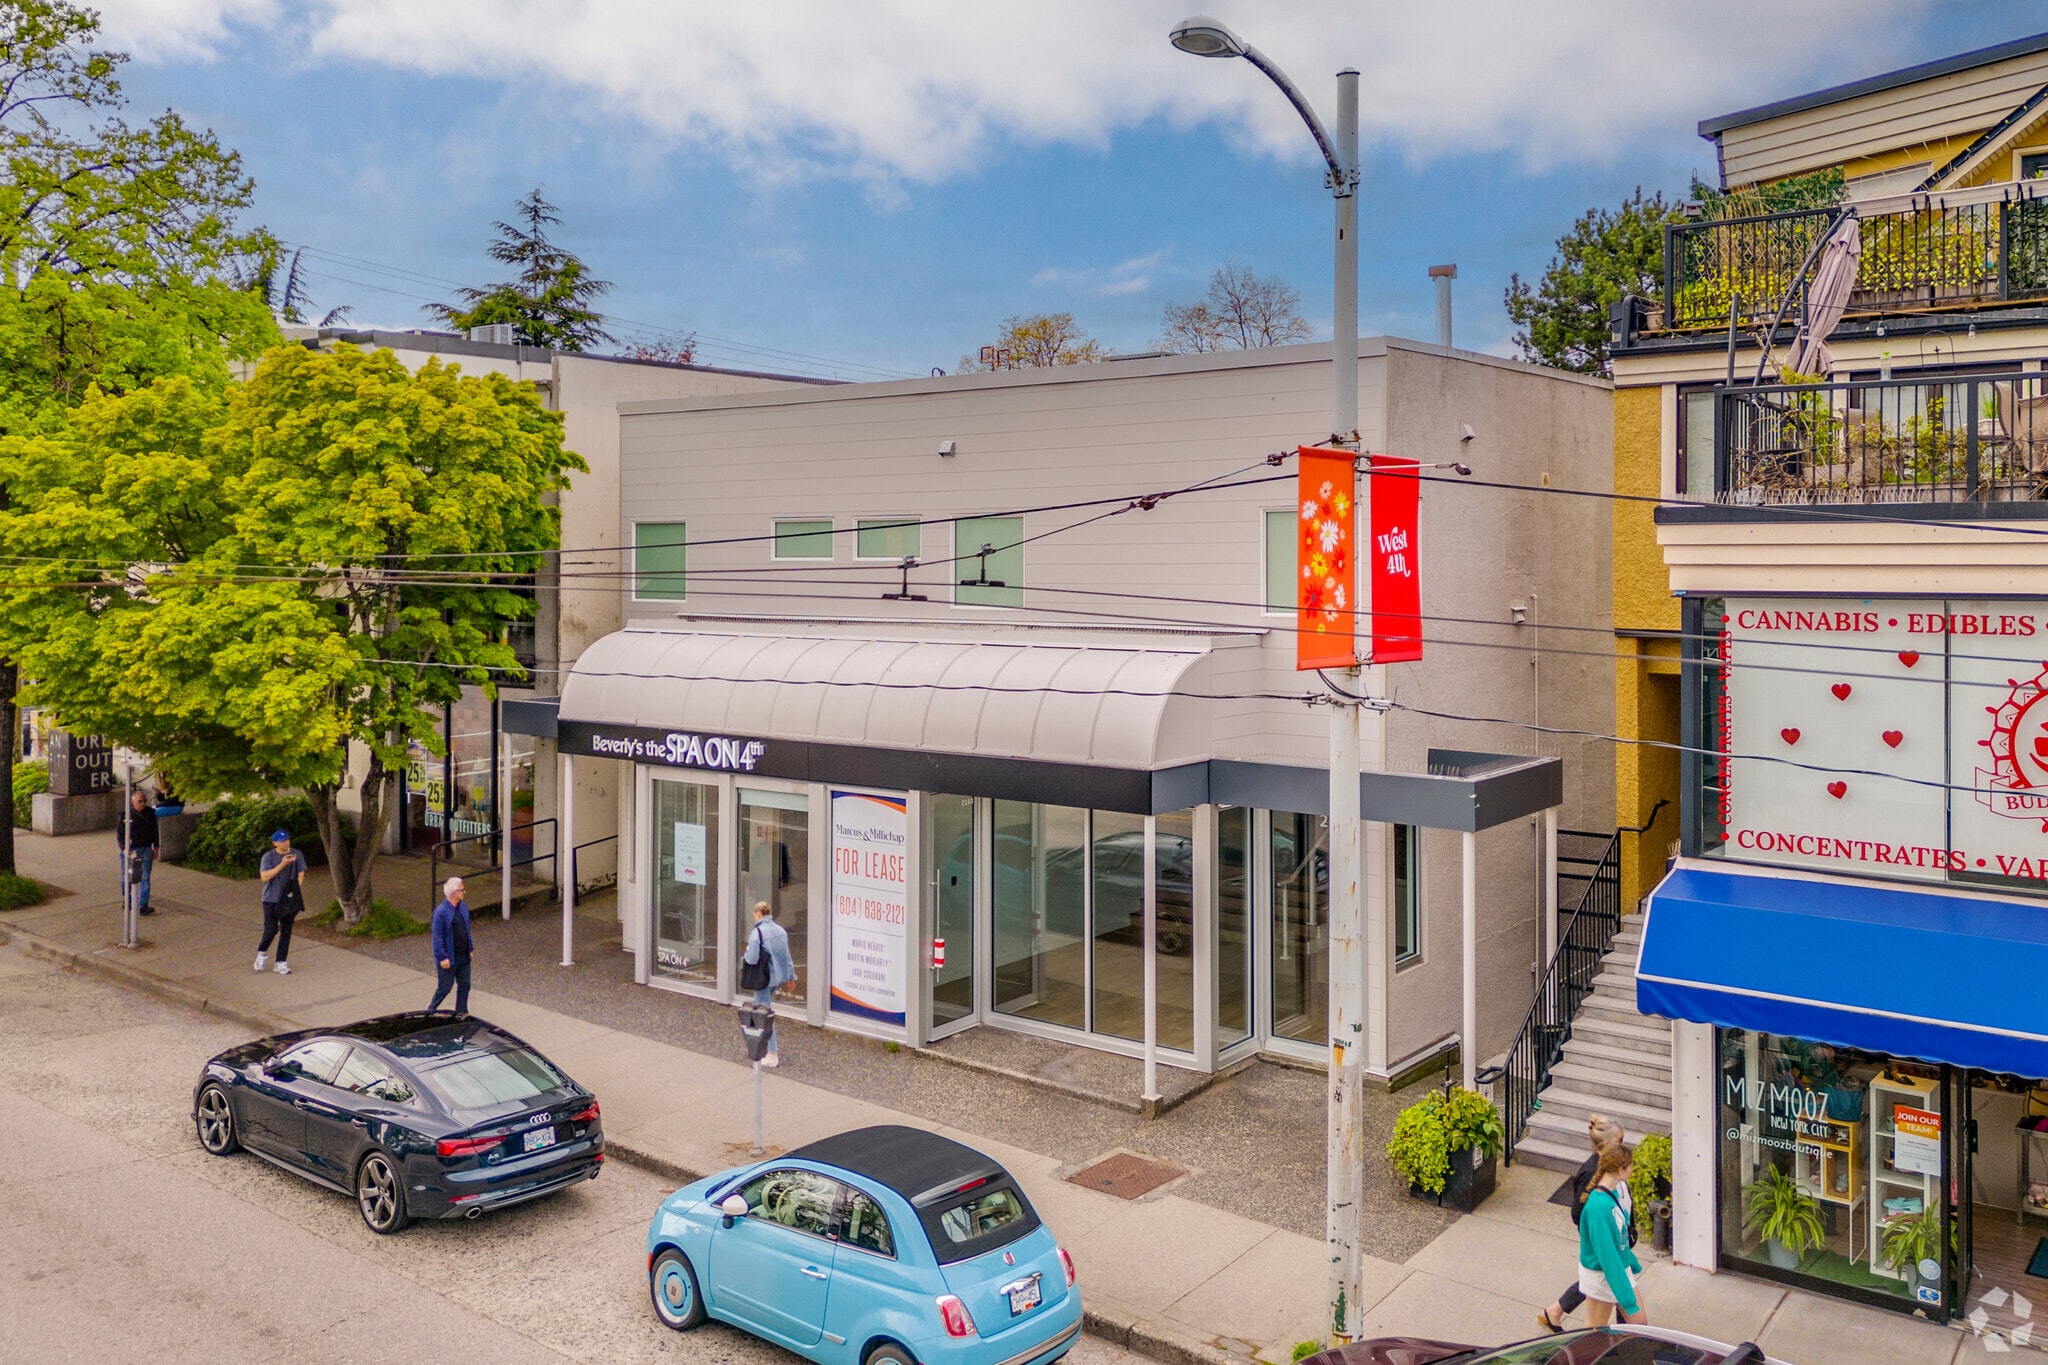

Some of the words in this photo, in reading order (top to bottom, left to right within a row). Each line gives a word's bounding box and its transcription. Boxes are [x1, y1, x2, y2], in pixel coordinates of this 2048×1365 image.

[1378, 526, 1408, 554] West
[1737, 610, 1880, 633] CANNABIS
[1907, 613, 2036, 637] EDIBLES
[592, 734, 644, 758] Beverly's
[645, 740, 666, 758] the
[76, 752, 111, 769] OUT
[1718, 695, 1733, 826] CONCENTRATES
[91, 772, 110, 788] ER
[449, 817, 492, 834] OUTFITTERS
[836, 823, 863, 838] Marcus
[862, 830, 870, 842] &
[869, 827, 905, 845] Millichap
[1737, 829, 1968, 872] CONCENTRATES
[835, 847, 859, 876] FOR
[865, 850, 905, 883] LEASE
[836, 893, 862, 919] (604)
[864, 899, 905, 925] 638-2121
[1897, 1111, 1919, 1123] JOIN
[1919, 1116, 1940, 1127] OUR
[1906, 1122, 1933, 1136] TEAM!
[1726, 1127, 1833, 1160] @mizmoozboutique
